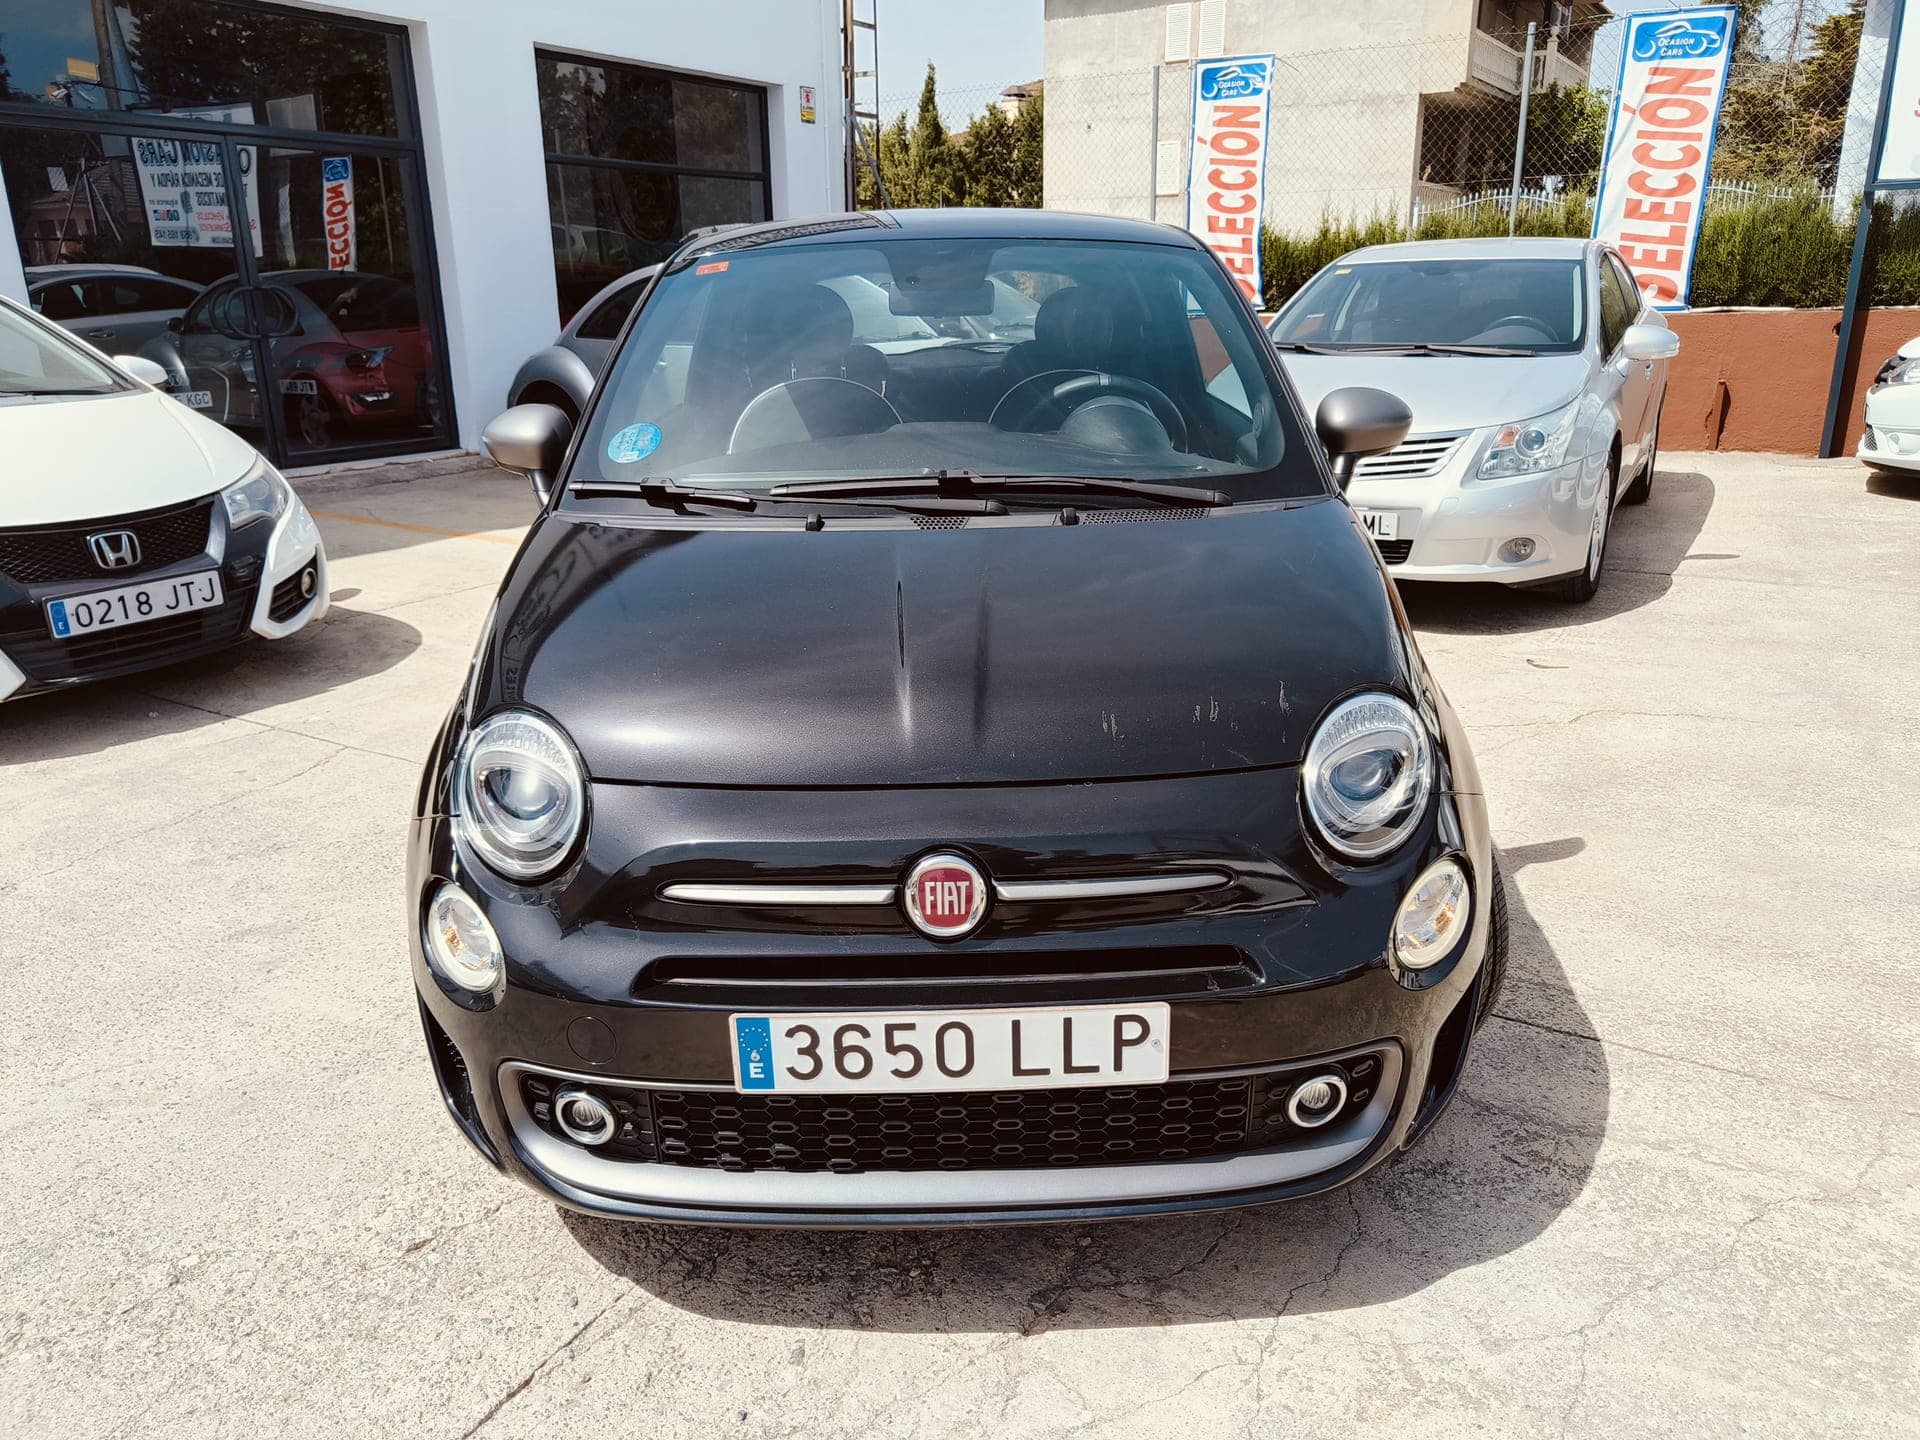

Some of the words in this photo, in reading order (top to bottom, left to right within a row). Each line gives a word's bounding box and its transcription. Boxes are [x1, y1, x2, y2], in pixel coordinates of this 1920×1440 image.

[1660, 47, 1683, 56] CARS
[74, 591, 153, 627] 0218
[165, 577, 216, 611] JTJ
[58, 622, 65, 631] E
[925, 880, 971, 917] FIAT
[784, 1021, 975, 1081] 3650
[1011, 1014, 1151, 1078] LLP
[749, 1063, 764, 1079] E
